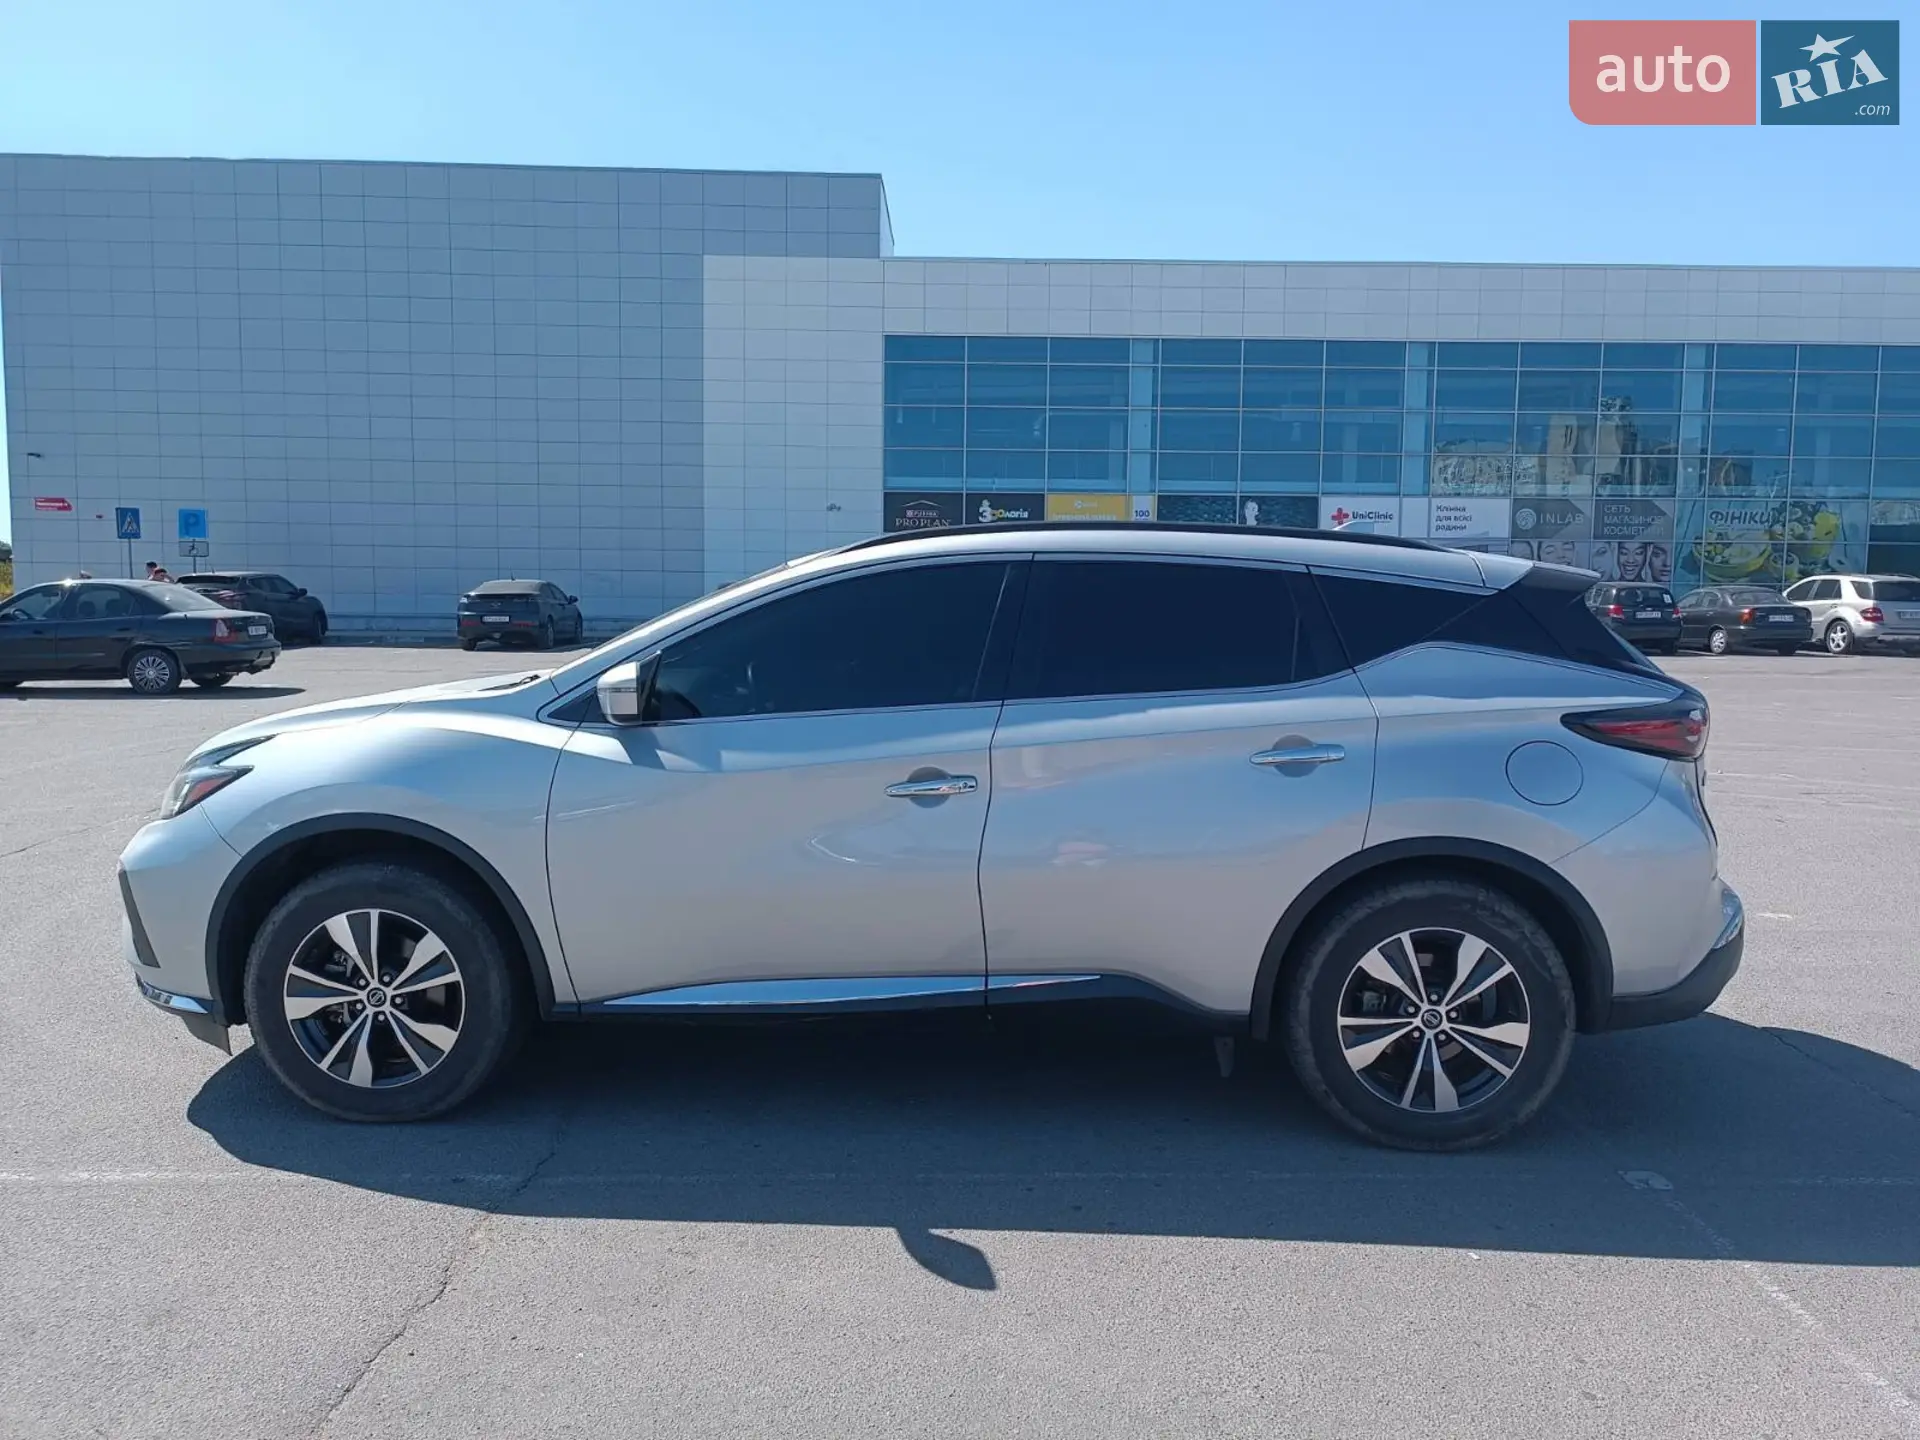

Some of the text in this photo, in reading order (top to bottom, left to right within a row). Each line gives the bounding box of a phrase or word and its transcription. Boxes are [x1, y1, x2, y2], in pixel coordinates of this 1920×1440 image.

[1134, 509, 1151, 518] 100
[1603, 504, 1632, 514] СЕТЬ
[1351, 511, 1394, 521] UniClinic
[1435, 514, 1452, 523] для
[1540, 512, 1584, 524] INLAB
[895, 517, 949, 528] PRO PLAN
